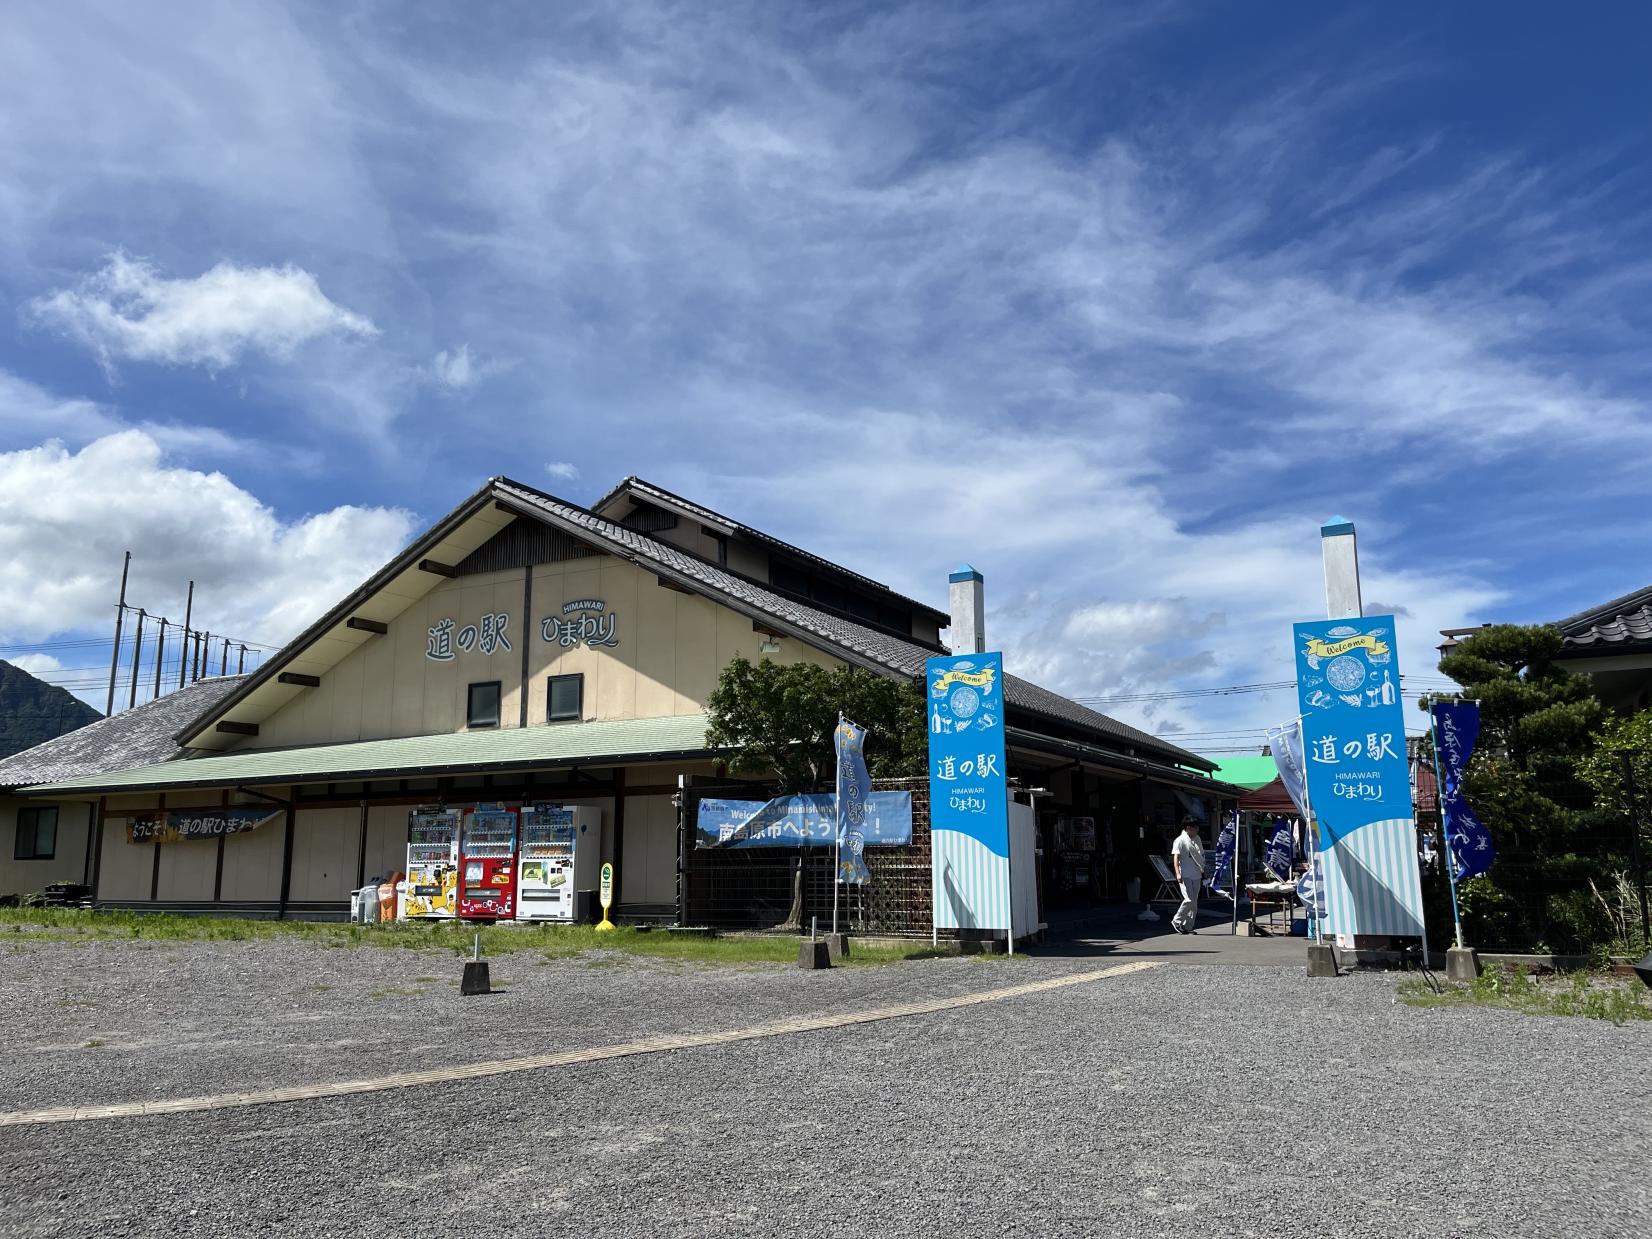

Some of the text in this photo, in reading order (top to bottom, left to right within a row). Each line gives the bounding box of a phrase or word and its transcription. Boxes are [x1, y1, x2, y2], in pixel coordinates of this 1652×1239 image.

[563, 600, 605, 614] HIMAWARI
[427, 613, 511, 661] 道の駅
[541, 613, 619, 648] ひまわり
[1326, 638, 1366, 656] Welcome
[951, 672, 982, 684] Welcome
[1312, 732, 1399, 765] 道の駅
[936, 753, 1000, 781] 道の駅
[1335, 771, 1380, 781] HIMAWARI
[951, 787, 985, 795] HIMAWARI
[1332, 782, 1385, 802] ひまわり
[949, 796, 987, 815] ひまわり
